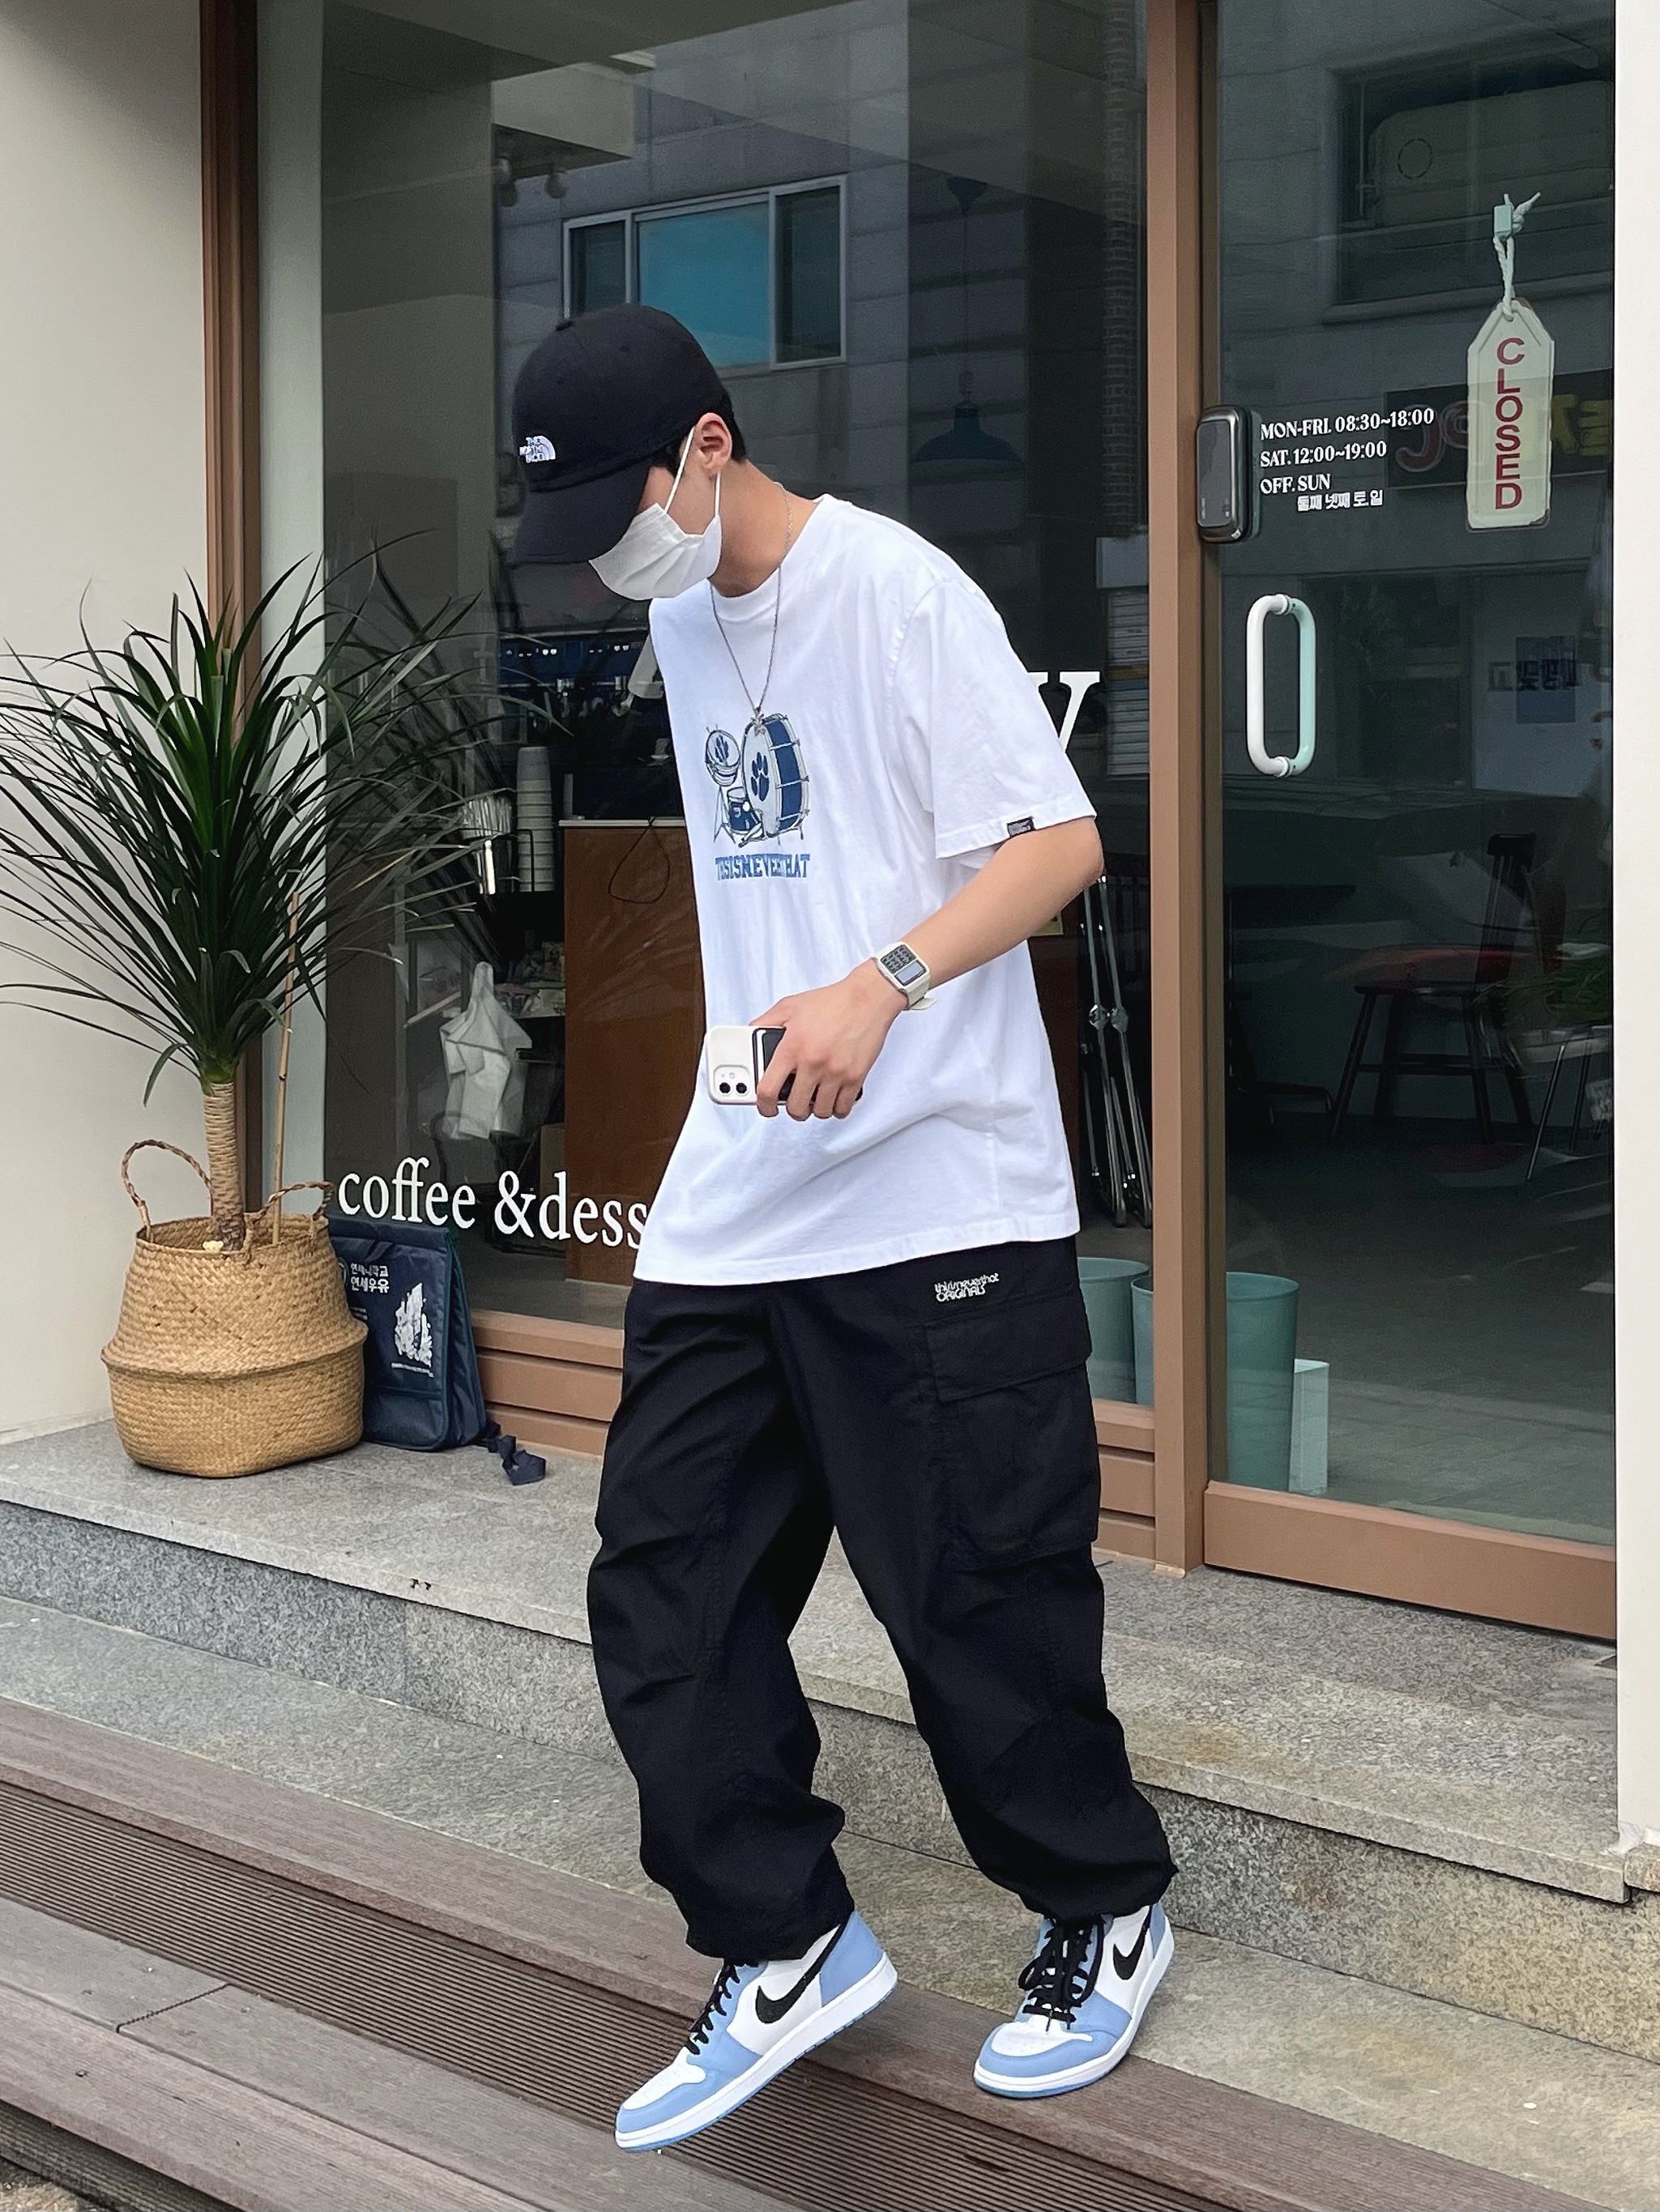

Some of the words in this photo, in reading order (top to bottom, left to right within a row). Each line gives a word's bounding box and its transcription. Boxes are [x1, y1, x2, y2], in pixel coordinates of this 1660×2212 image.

[1261, 417, 1332, 441] MON-FRI.
[1334, 407, 1435, 433] 08:30~18:00
[1495, 337, 1526, 510] CLOSED
[1260, 449, 1292, 467] SAT.
[1293, 440, 1387, 465] 12:00~19:00
[1260, 476, 1295, 495] OFF.
[1297, 473, 1331, 492] SUN
[1297, 494, 1323, 512] 둘째
[1325, 492, 1351, 509] 넷째
[338, 1157, 476, 1229] coffee
[351, 1276, 390, 1294] 연세우유
